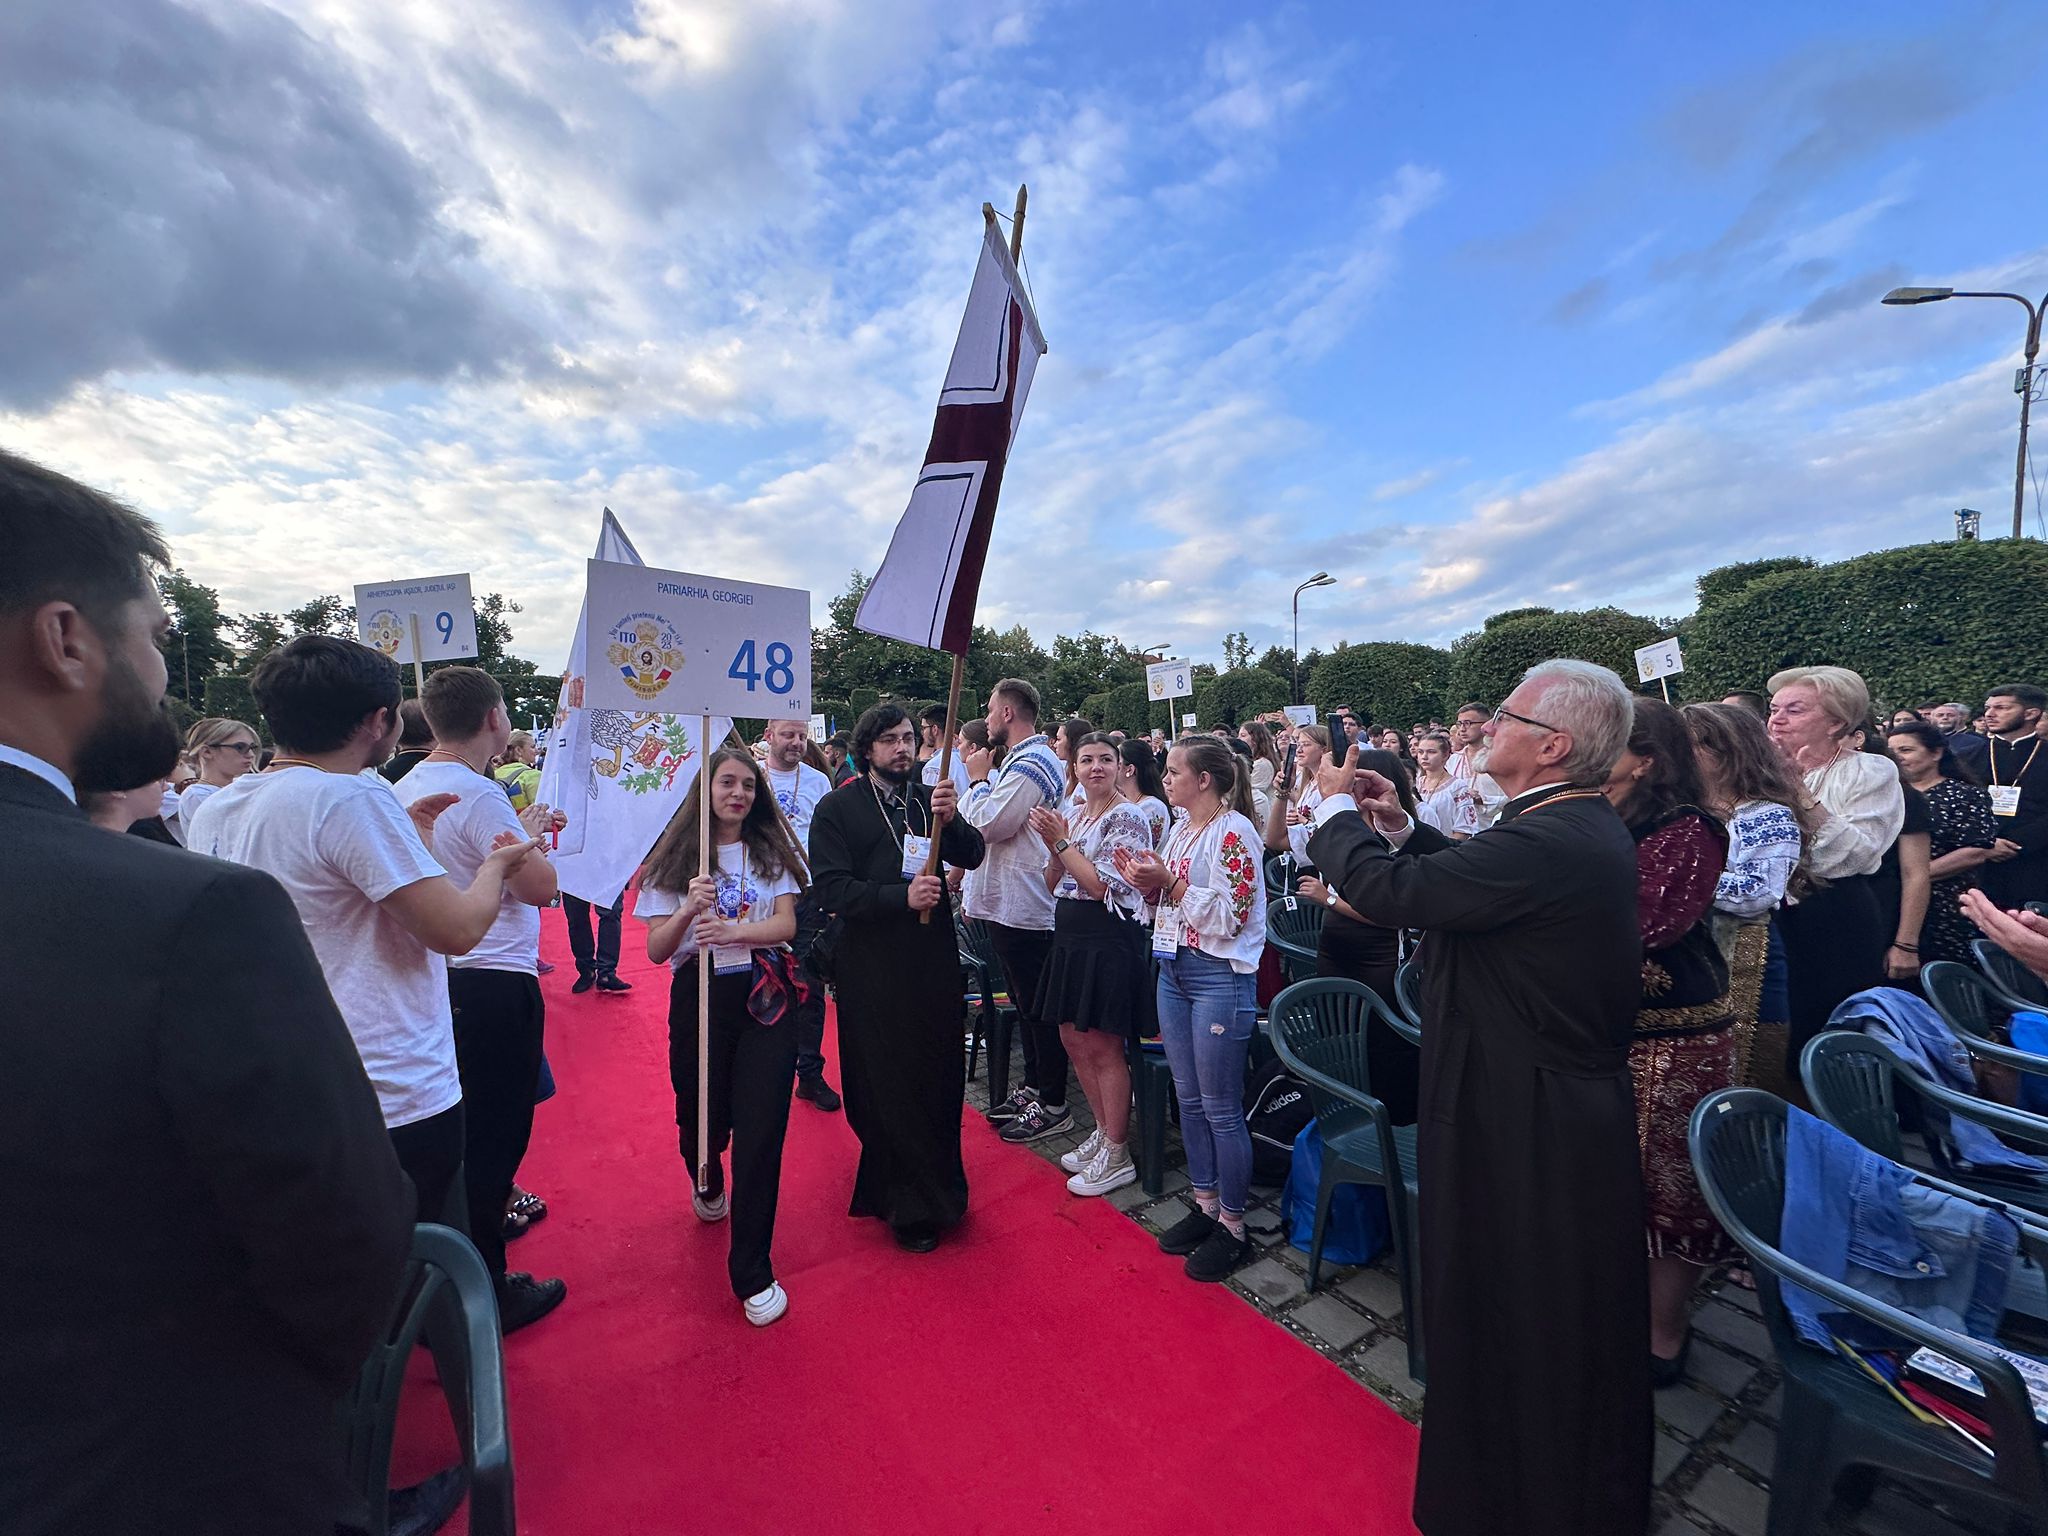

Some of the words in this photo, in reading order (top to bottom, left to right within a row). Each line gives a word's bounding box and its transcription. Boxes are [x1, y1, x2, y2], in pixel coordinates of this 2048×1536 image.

[657, 582, 709, 600] PATRIARHIA
[712, 590, 754, 606] GEORGIEI
[435, 612, 454, 645] 9
[620, 631, 637, 644] ITO
[661, 632, 672, 641] 20
[661, 640, 672, 649] 23
[728, 639, 794, 695] 48
[1665, 653, 1674, 668] 5
[1176, 674, 1184, 690] 8
[789, 699, 801, 709] H1
[1305, 714, 1312, 725] 3
[1287, 897, 1293, 907] B
[1263, 1090, 1302, 1114] adidas
